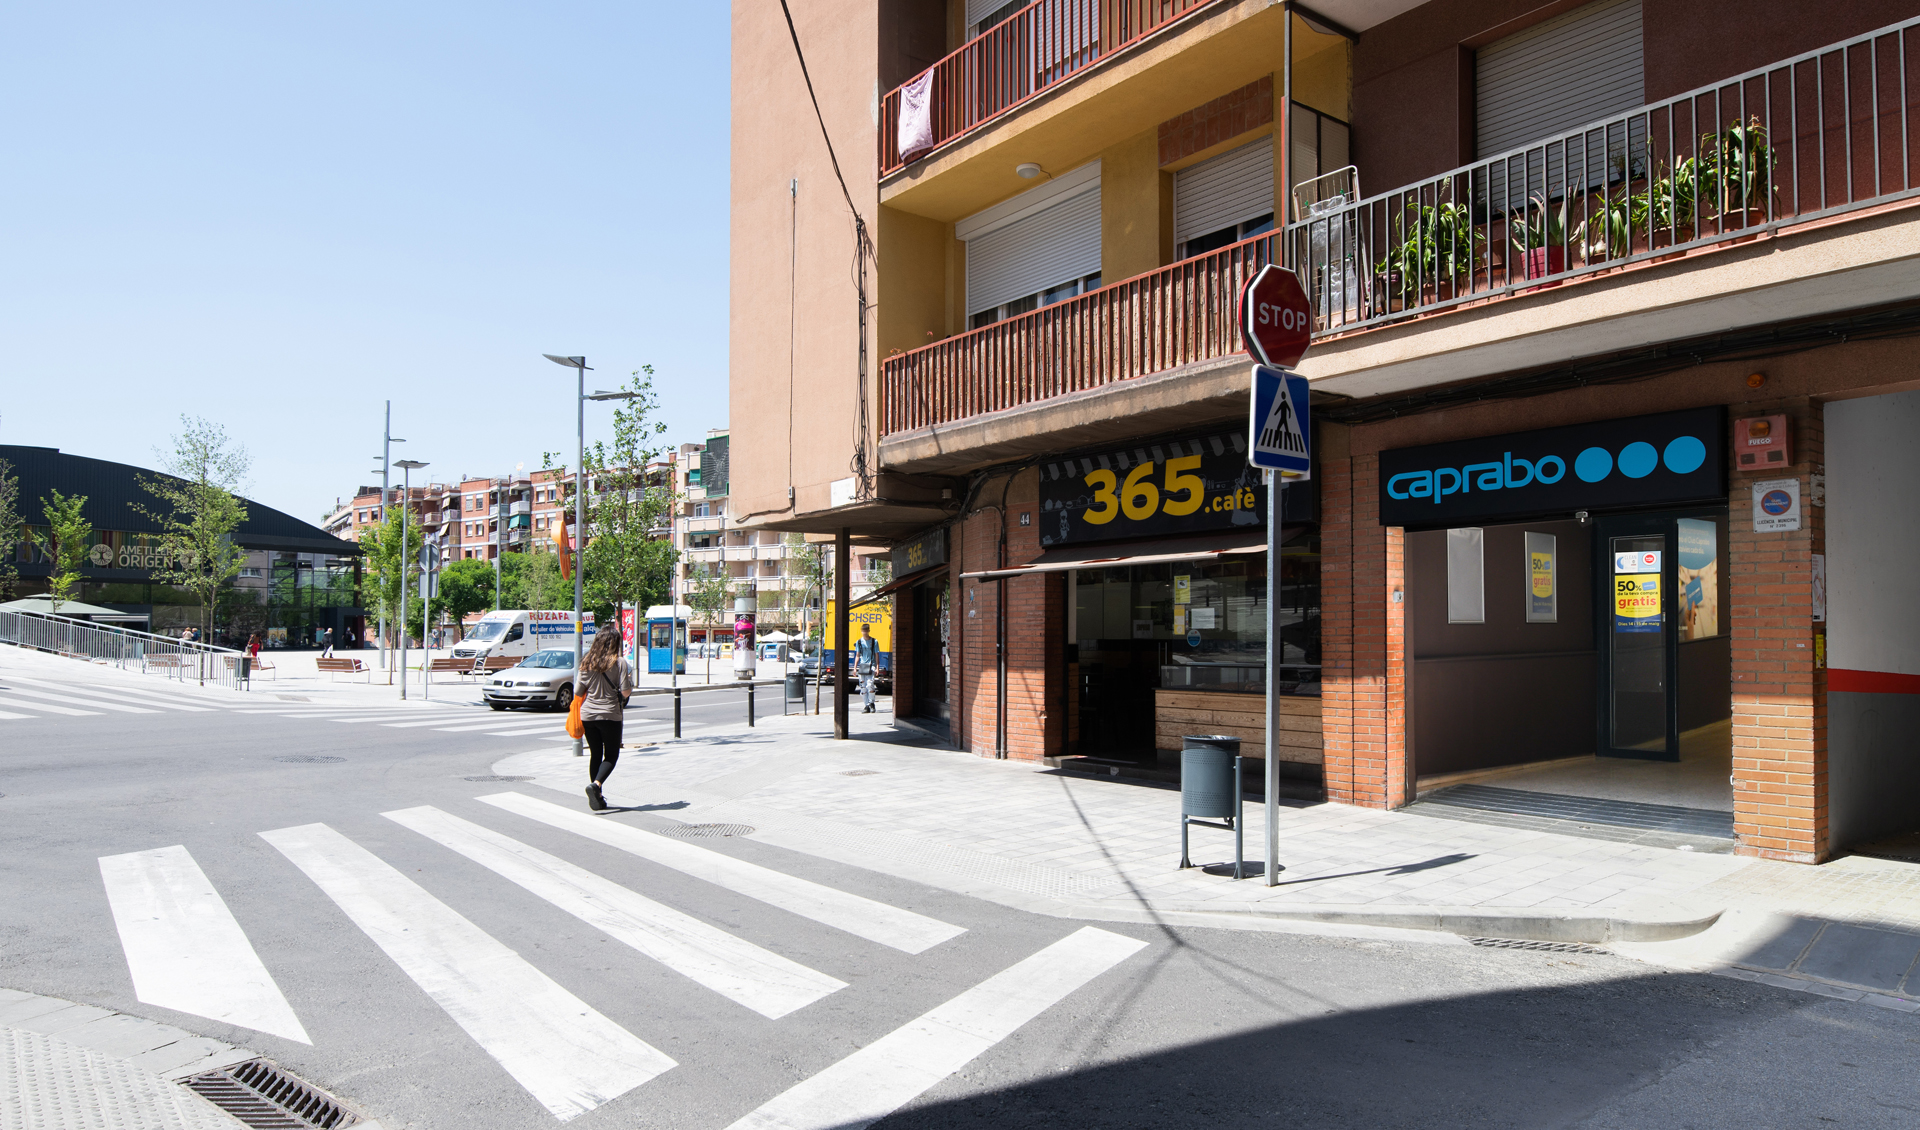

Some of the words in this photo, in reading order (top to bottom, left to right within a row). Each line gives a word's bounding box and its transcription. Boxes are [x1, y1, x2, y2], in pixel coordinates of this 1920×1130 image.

[1258, 302, 1307, 332] STOP
[1387, 451, 1566, 504] caprabo
[1020, 514, 1030, 525] 44
[118, 545, 174, 556] AMETLLER
[908, 543, 922, 569] 365
[118, 554, 174, 569] ORIGEN
[1533, 575, 1551, 588] gratis
[1617, 580, 1642, 592] 50%
[1618, 596, 1657, 609] gratis
[529, 612, 570, 621] RUZAFA
[849, 612, 883, 624] CHSER
